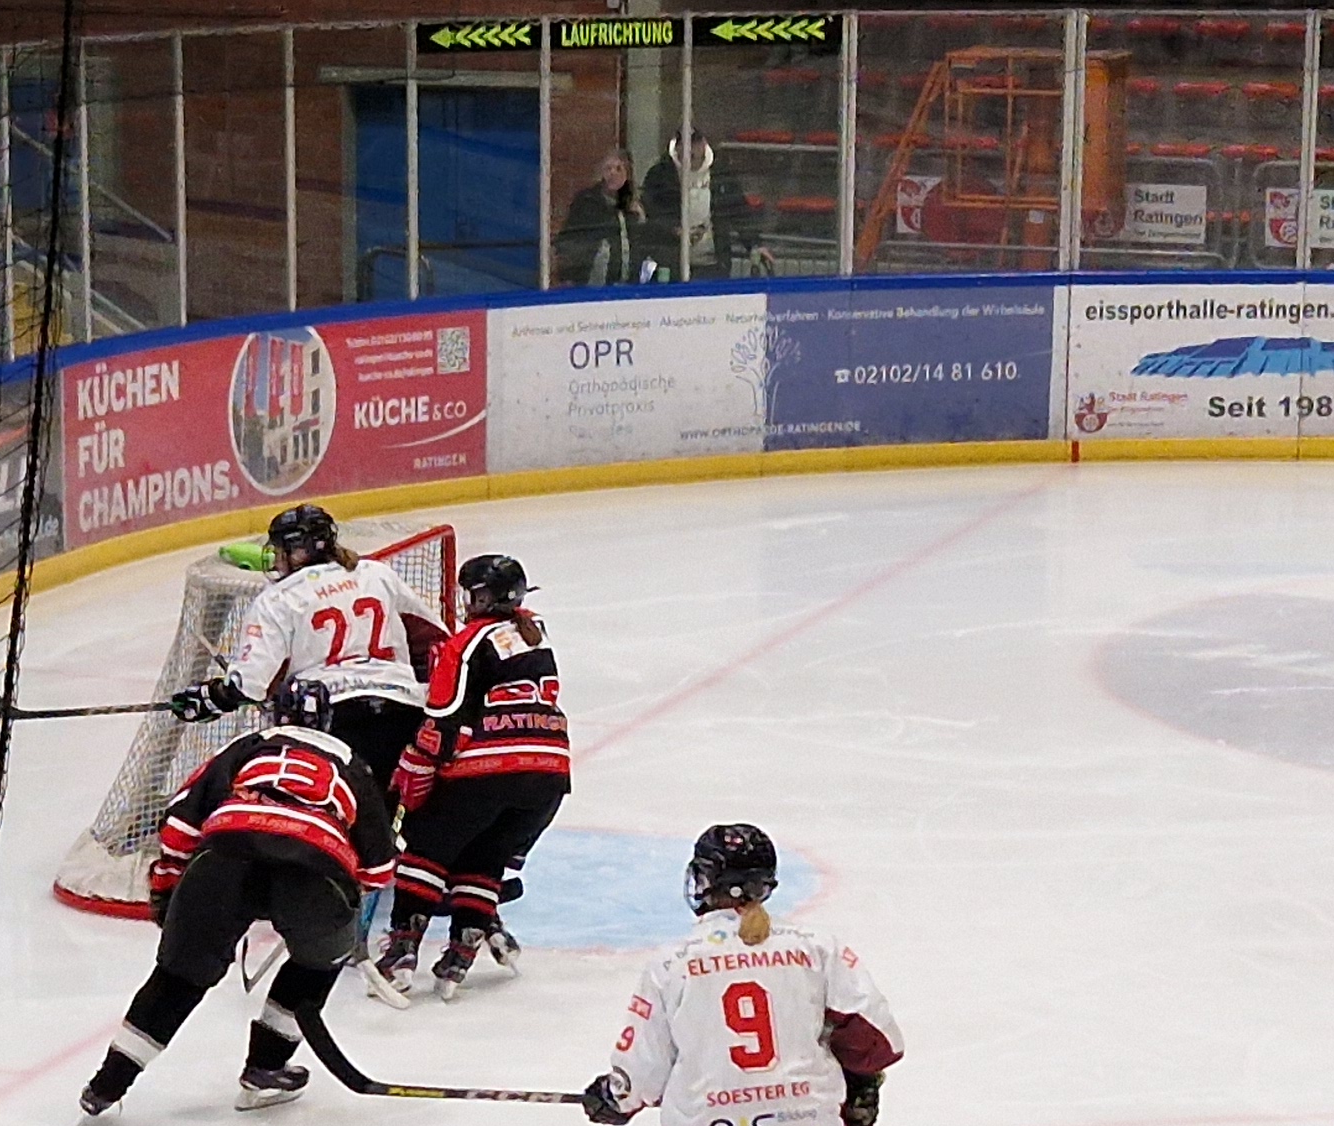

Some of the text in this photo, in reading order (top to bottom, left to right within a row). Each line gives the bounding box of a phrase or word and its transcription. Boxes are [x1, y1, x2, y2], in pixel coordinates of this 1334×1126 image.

[560, 20, 674, 47] LAUFRICHTUNG
[1134, 189, 1175, 204] Stadt
[1133, 209, 1203, 227] Ratingen
[896, 305, 959, 321] Behandlung
[569, 338, 635, 371] OPR
[568, 375, 676, 398] Orthopädische
[854, 361, 945, 386] 02102/14
[951, 361, 973, 383] 81
[77, 361, 181, 422] KÜCHEN
[1109, 391, 1189, 405] Stadt Ratingen
[1207, 395, 1266, 419] Seit
[77, 420, 126, 479] FÜR
[413, 453, 467, 470] RATINGEN
[78, 460, 240, 533] CHAMPIONS.
[315, 578, 359, 600] HAHN
[310, 596, 397, 667] 22
[687, 949, 813, 977] ELTERMANN
[616, 1026, 635, 1052] 9
[722, 980, 777, 1072] 9
[706, 1081, 811, 1108] SOESTER EG
